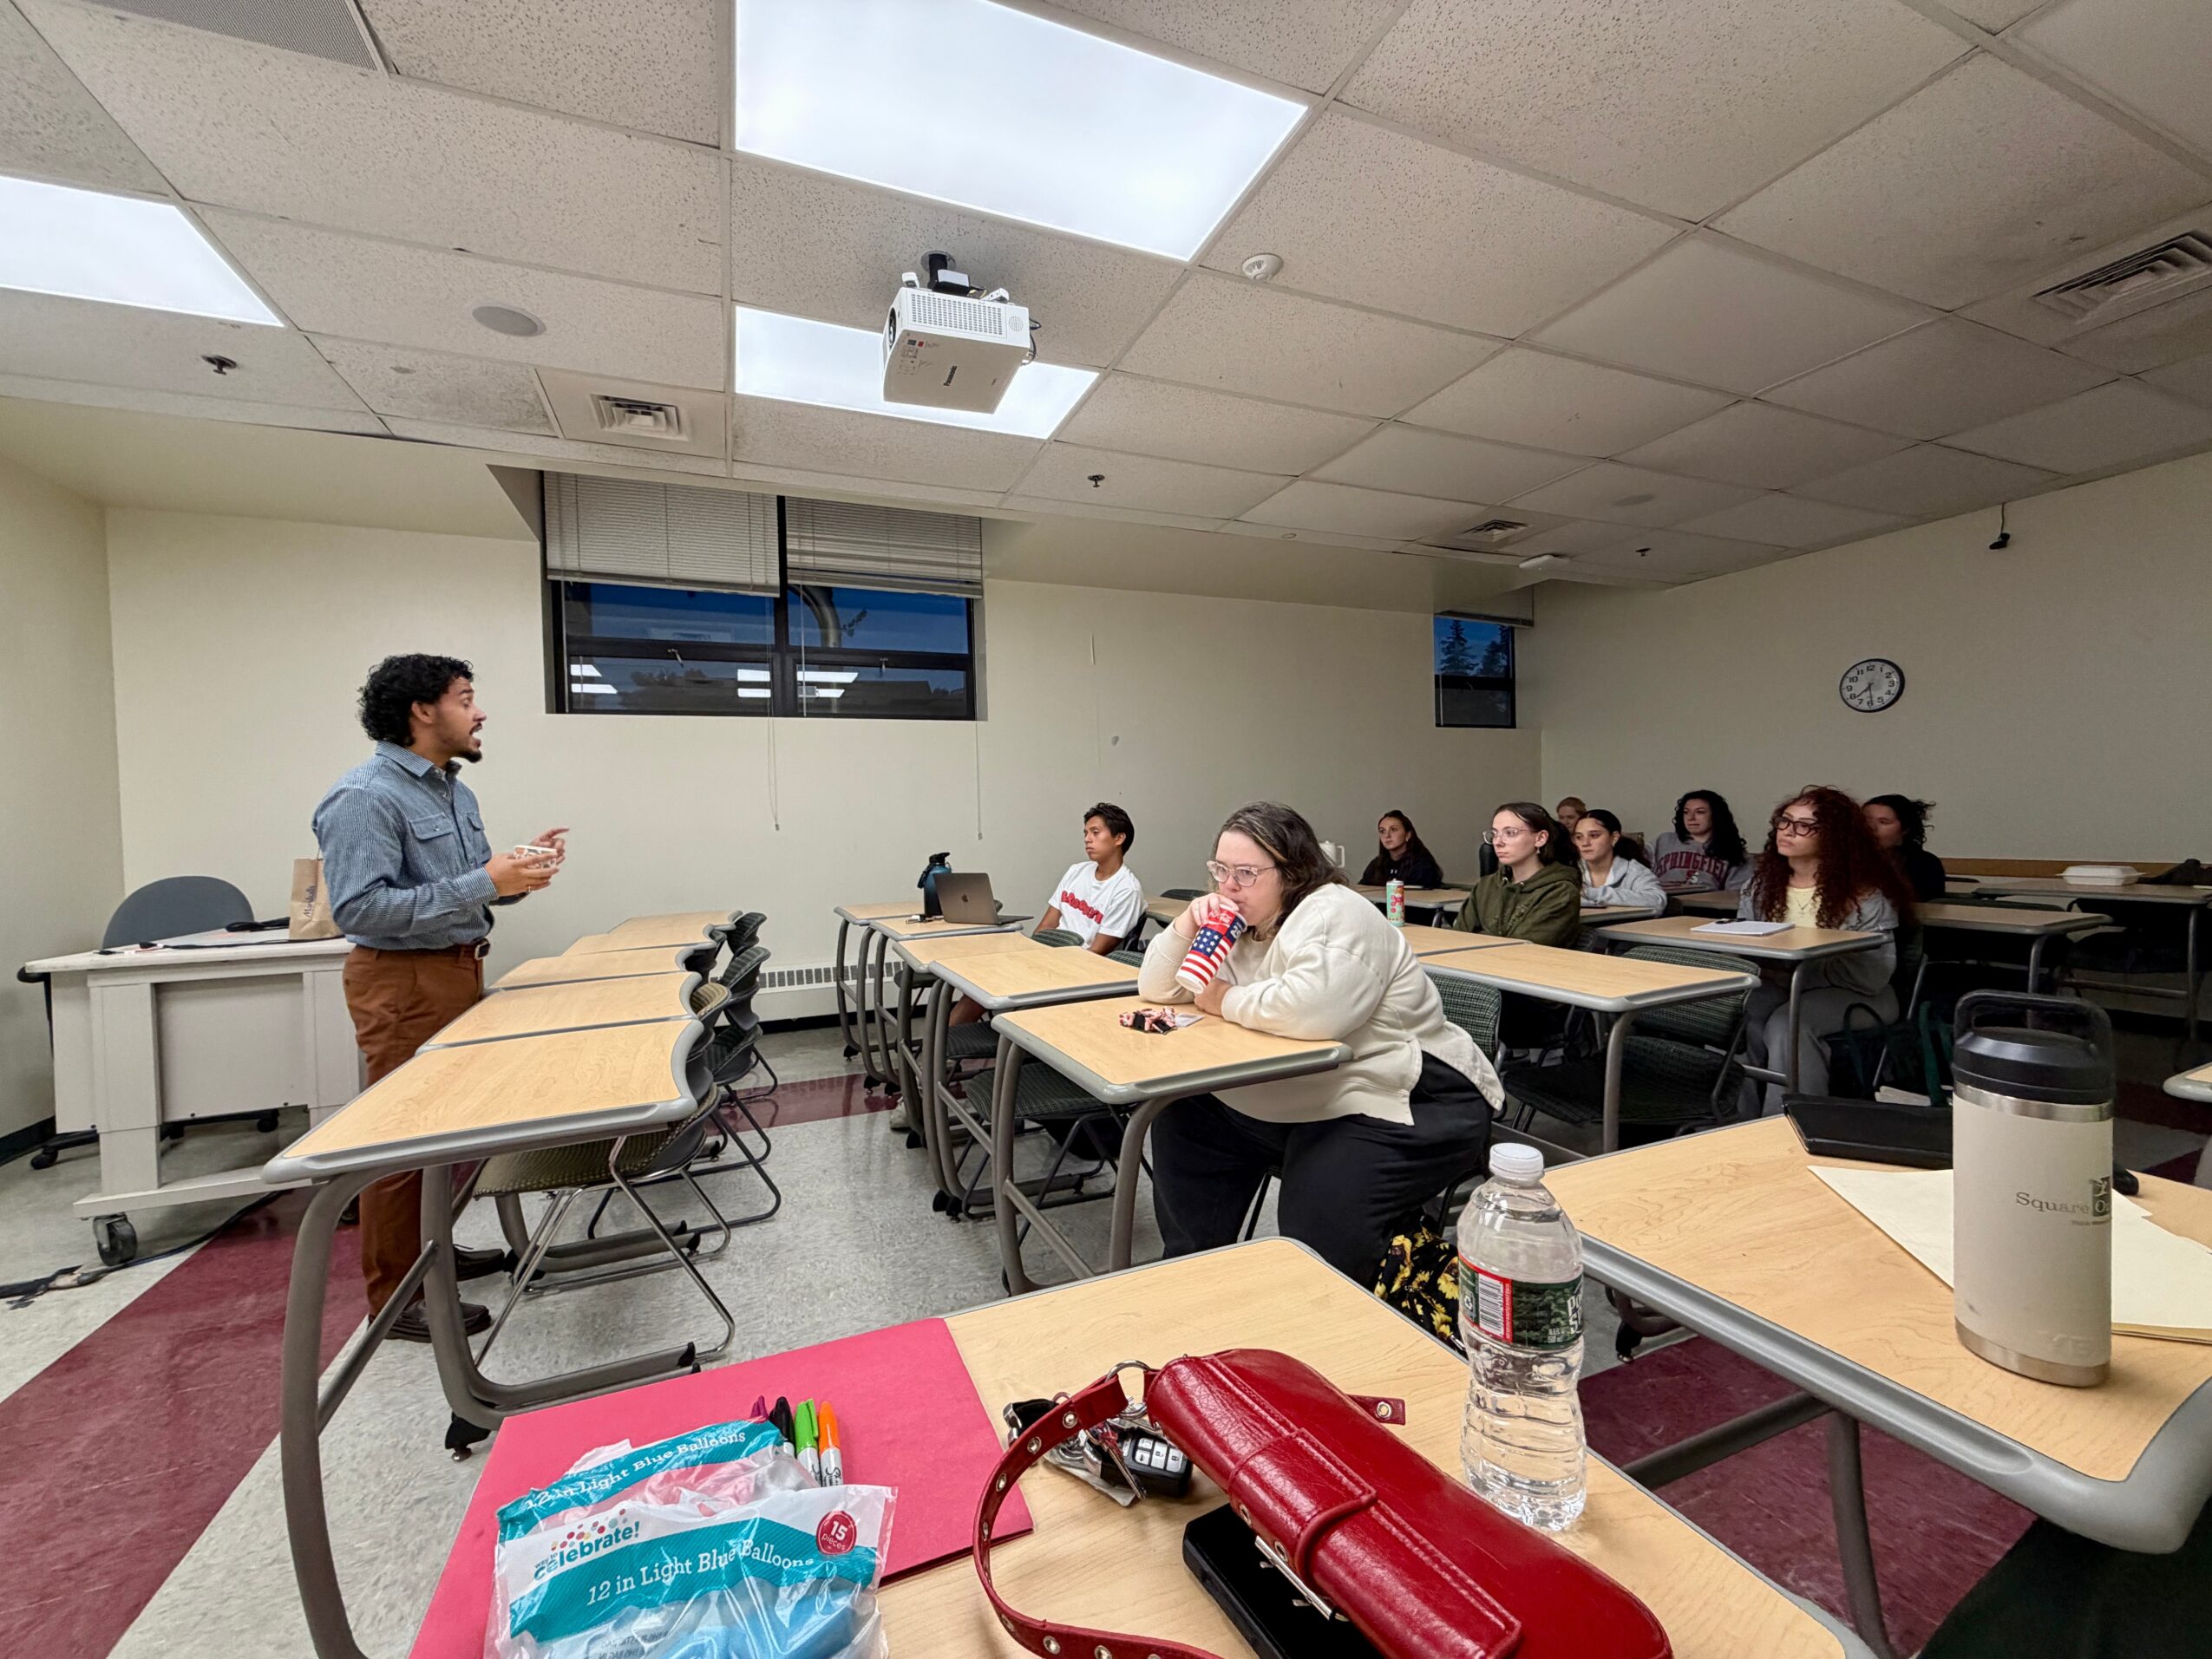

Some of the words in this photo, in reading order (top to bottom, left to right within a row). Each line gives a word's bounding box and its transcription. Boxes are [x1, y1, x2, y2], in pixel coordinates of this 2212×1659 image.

[2015, 1191, 2090, 1213] Square
[525, 1492, 552, 1509] 12
[579, 1469, 631, 1493] Light
[633, 1452, 674, 1473] Blue
[676, 1432, 747, 1456] Balloons
[831, 1520, 848, 1541] 15
[533, 1520, 640, 1581] celebrate!
[821, 1533, 847, 1551] pieces
[550, 1552, 559, 1561] to
[586, 1579, 612, 1606] 12
[615, 1575, 637, 1595] in
[640, 1557, 692, 1586] Light
[697, 1549, 736, 1573] Blue
[741, 1539, 815, 1569] Balloons
